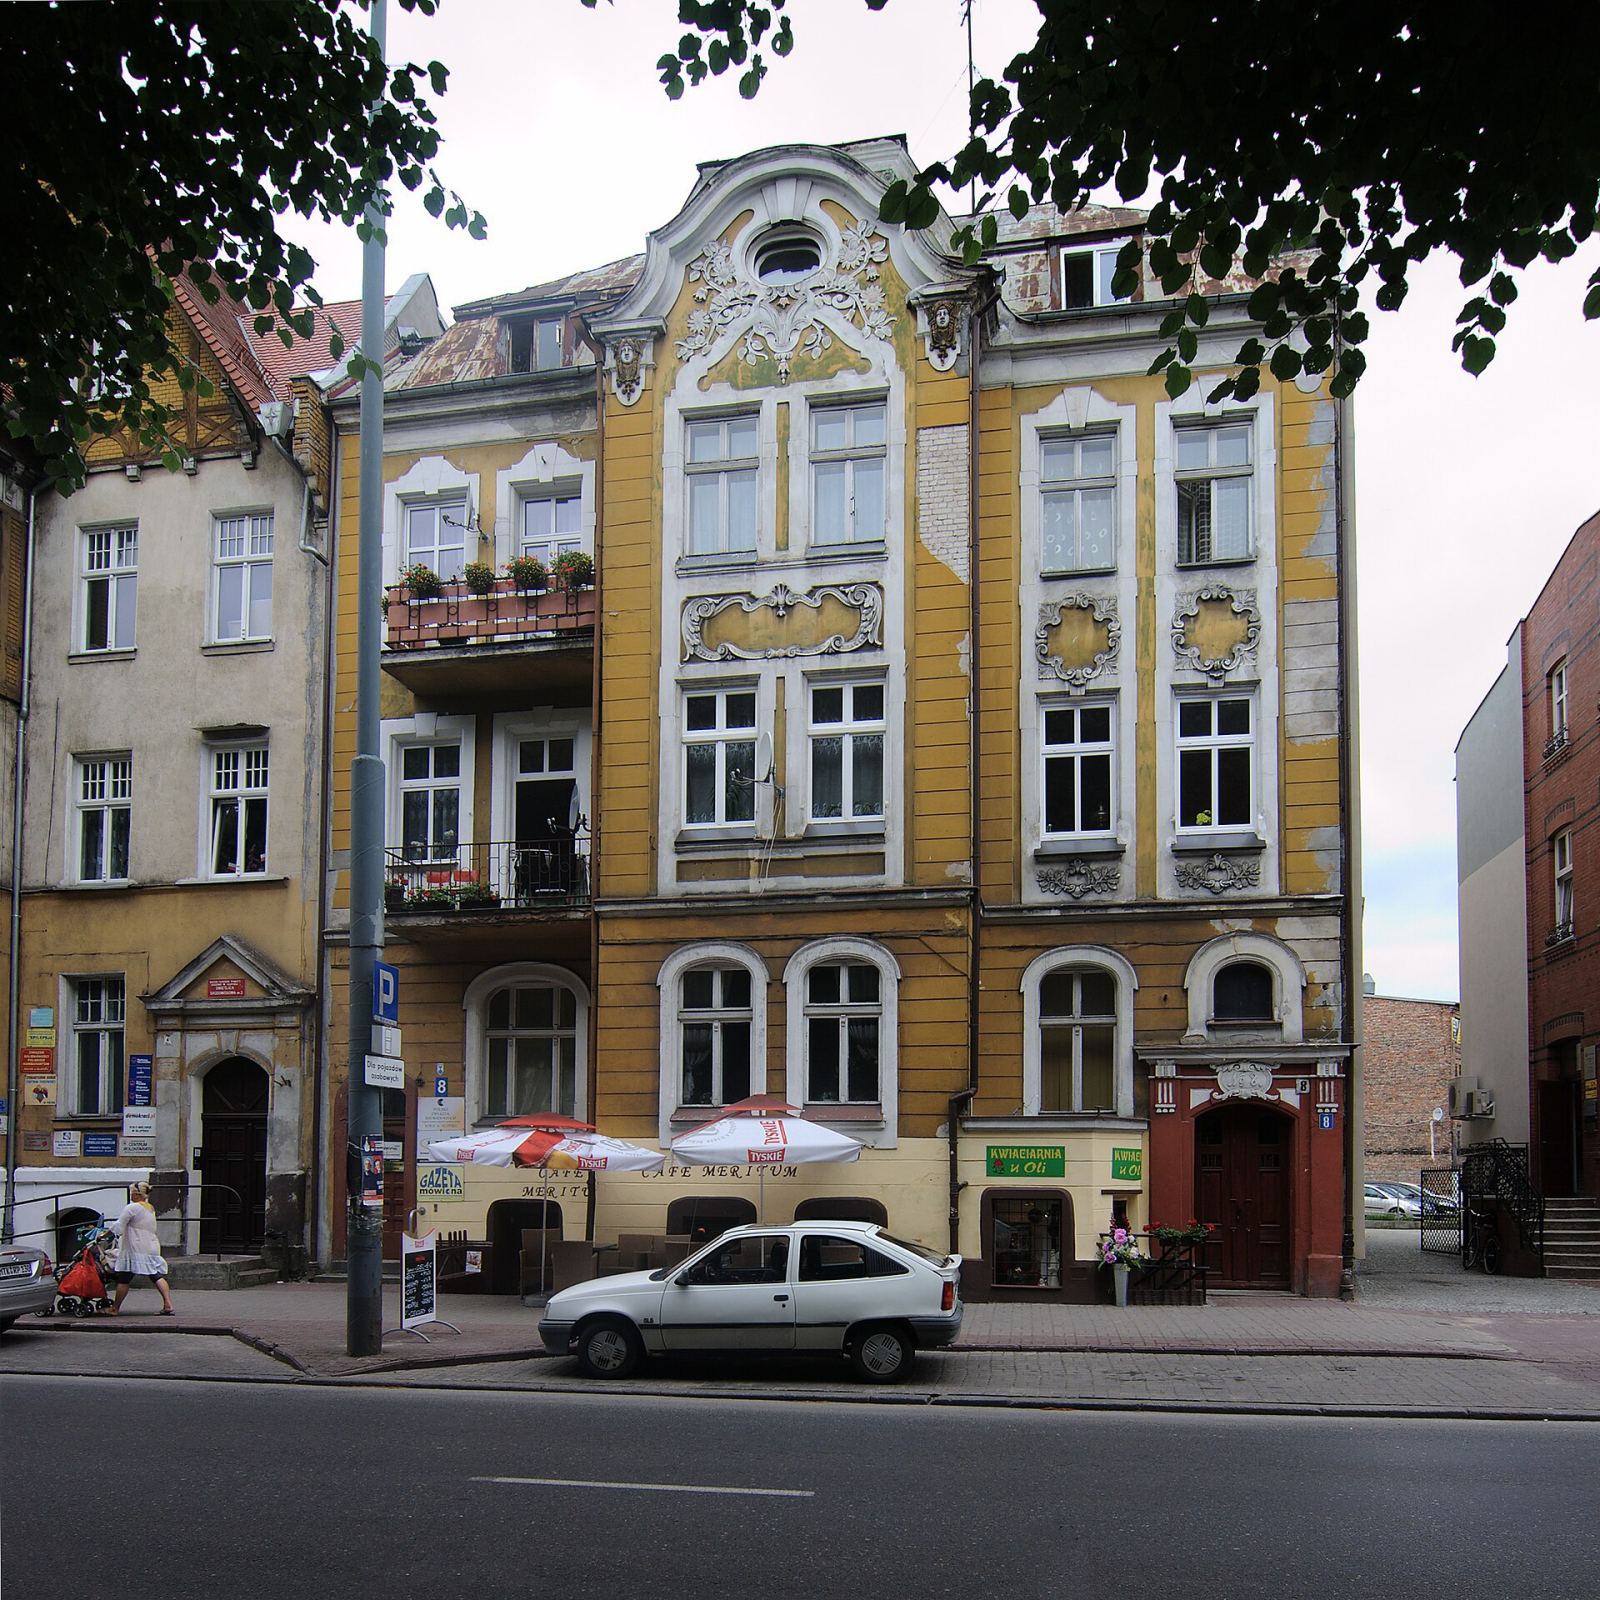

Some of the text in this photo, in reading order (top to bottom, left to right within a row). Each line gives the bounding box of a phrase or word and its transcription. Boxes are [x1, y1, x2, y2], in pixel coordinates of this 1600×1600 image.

[378, 968, 394, 1016] P
[366, 1060, 403, 1073] Dla pojazdów
[371, 1073, 399, 1084] osobowych
[437, 1079, 447, 1094] 8
[1300, 1080, 1308, 1091] 8
[1323, 1116, 1330, 1128] 8
[759, 1119, 780, 1145] TYSKIE
[751, 1150, 784, 1162] TYSKIE
[990, 1148, 1062, 1160] KWIACIARNIA
[580, 1157, 606, 1168] TYSKIE
[1024, 1161, 1046, 1174] Oli
[419, 1167, 462, 1188] GAZETA
[641, 1165, 798, 1179] CAFE MERITUM
[522, 1186, 589, 1199] MERITU
